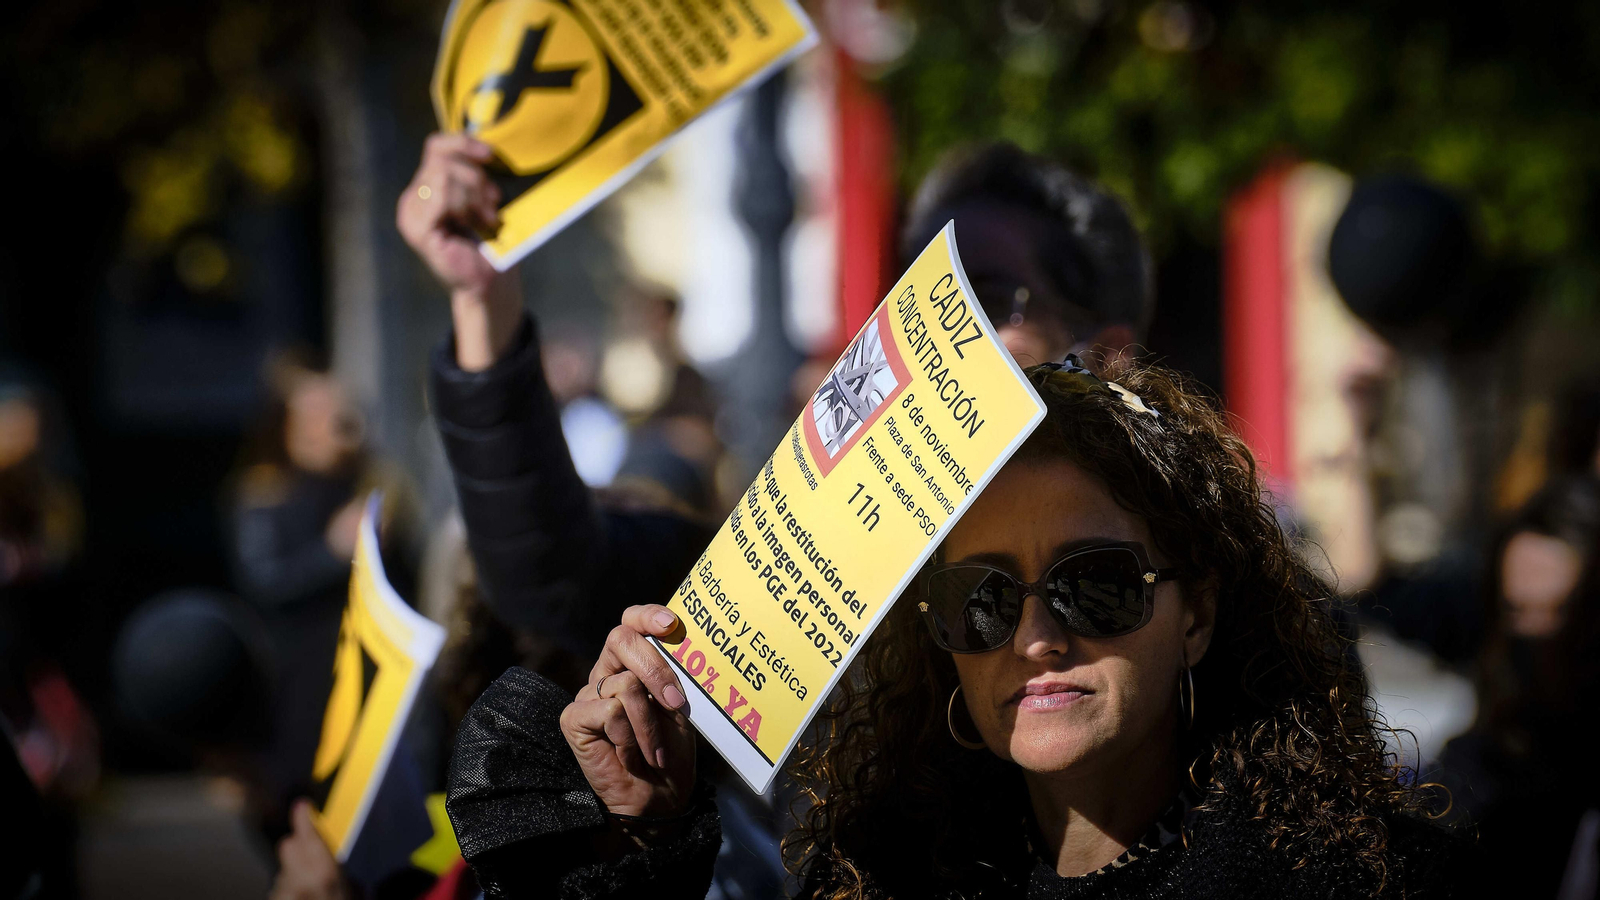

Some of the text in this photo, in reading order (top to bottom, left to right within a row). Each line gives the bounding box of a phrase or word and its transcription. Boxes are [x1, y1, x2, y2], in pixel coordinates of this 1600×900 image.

[896, 284, 985, 439] CONCENTRACIÓN
[862, 436, 939, 540] Frente a sede PSO
[884, 416, 955, 515] Plaza de San Antonio
[902, 393, 975, 496] 8 de noviembre
[751, 505, 761, 518] a
[755, 510, 767, 531] la
[762, 523, 803, 584] imagen
[764, 477, 780, 502] que
[775, 494, 787, 516] la
[782, 511, 843, 593] restitución
[841, 590, 867, 620] del
[847, 482, 881, 533] 11h
[682, 589, 767, 692] ESENCIALES
[699, 560, 808, 702] Barbería y Estética
[735, 529, 749, 549] en
[743, 542, 762, 571] los
[758, 564, 788, 602] PGE
[783, 599, 809, 629] del
[804, 622, 843, 669] 2022
[797, 580, 860, 648] personal
[672, 637, 762, 743] 10% YA
